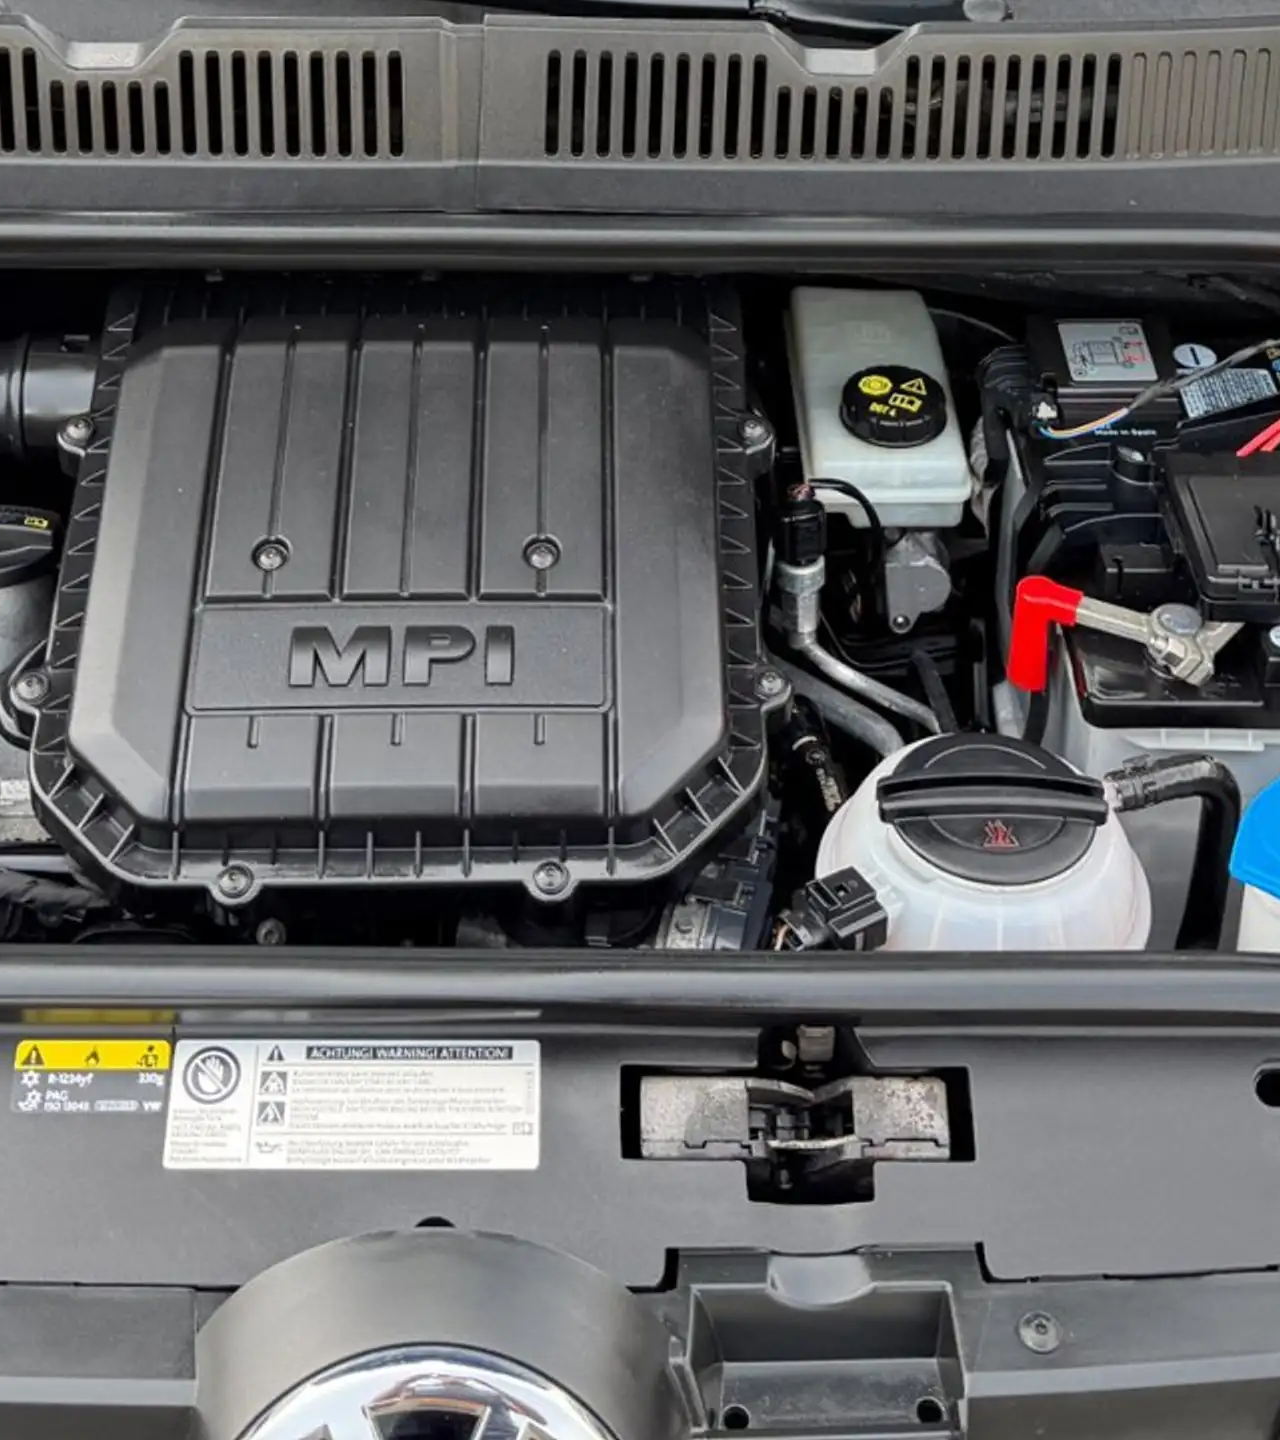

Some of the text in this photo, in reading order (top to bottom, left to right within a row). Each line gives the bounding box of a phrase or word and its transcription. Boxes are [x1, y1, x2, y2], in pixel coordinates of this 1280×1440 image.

[288, 625, 515, 687] MPI
[310, 1046, 508, 1059] ACHTUNG! WARNING! ATTENTION!
[45, 1090, 68, 1102] PAG
